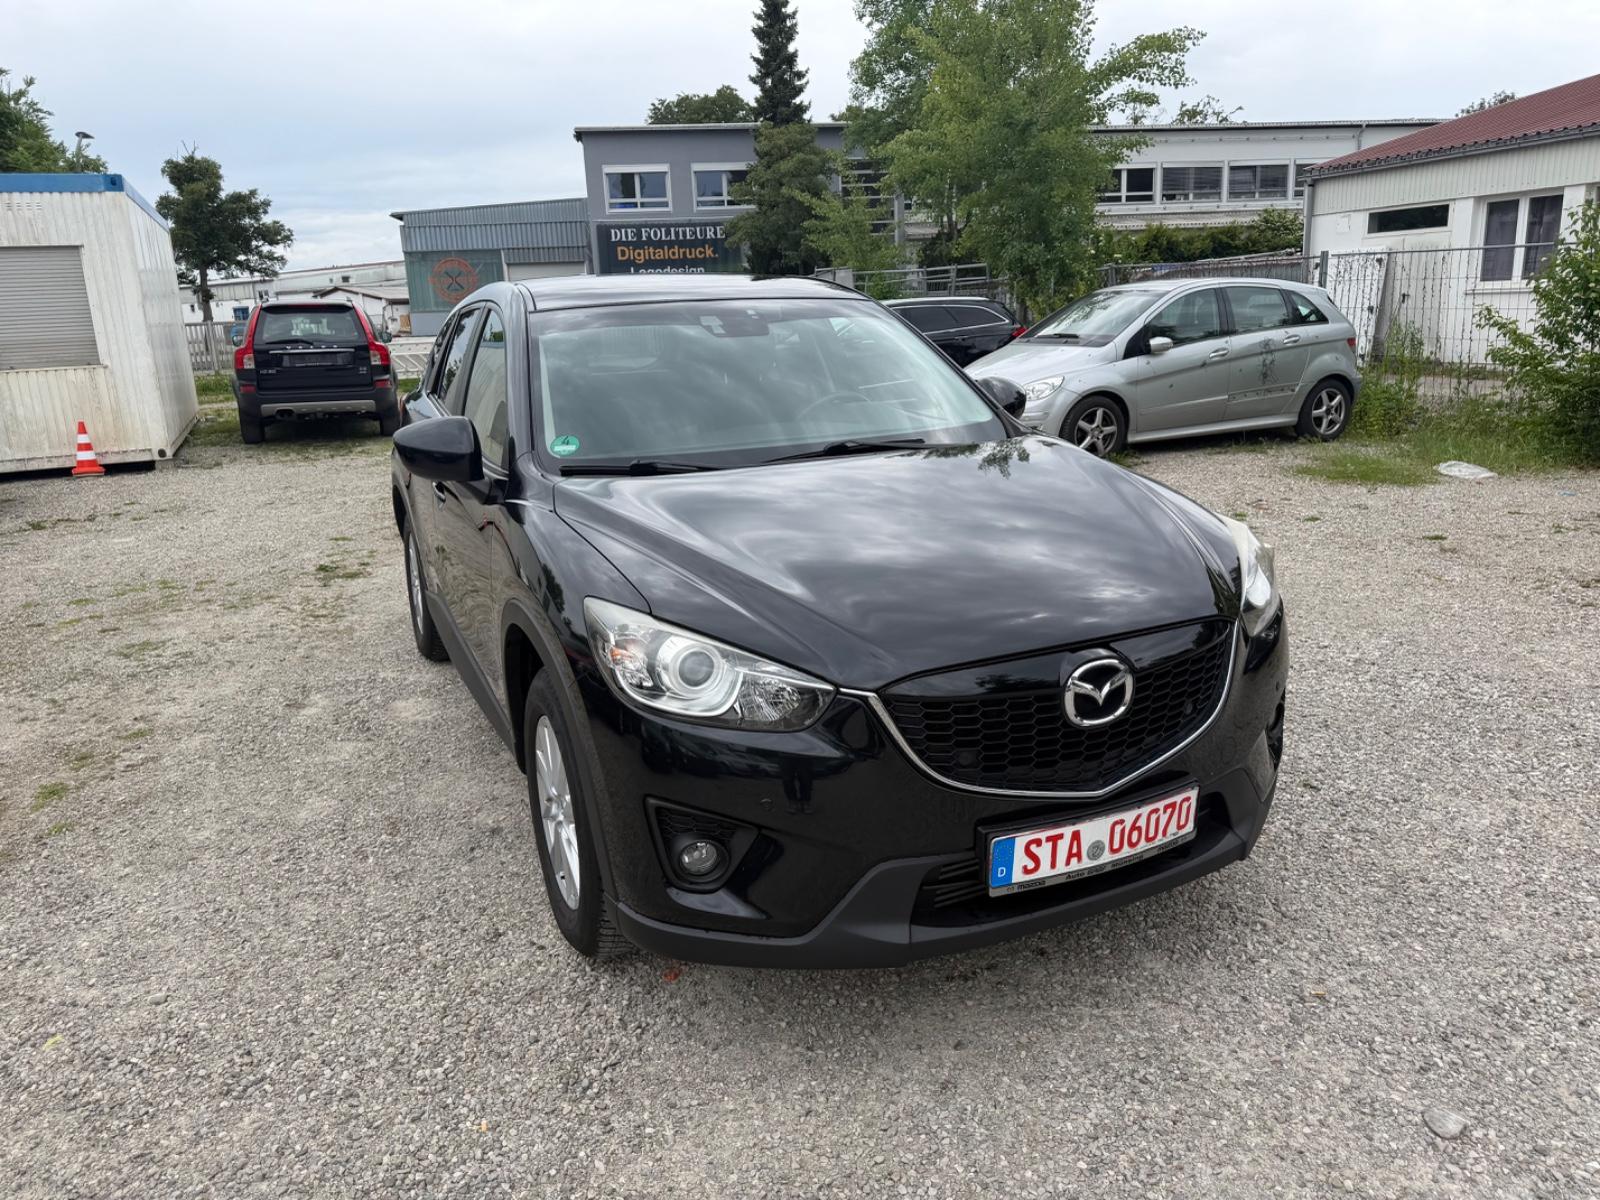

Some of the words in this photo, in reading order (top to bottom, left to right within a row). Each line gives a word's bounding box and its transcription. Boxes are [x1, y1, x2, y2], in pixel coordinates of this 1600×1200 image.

[610, 228, 637, 242] DIE
[641, 226, 726, 240] FOLITEURE
[617, 244, 718, 263] Digitaldruck.
[1022, 829, 1082, 875] STA
[1109, 796, 1191, 854] 06070
[997, 867, 1006, 878] D
